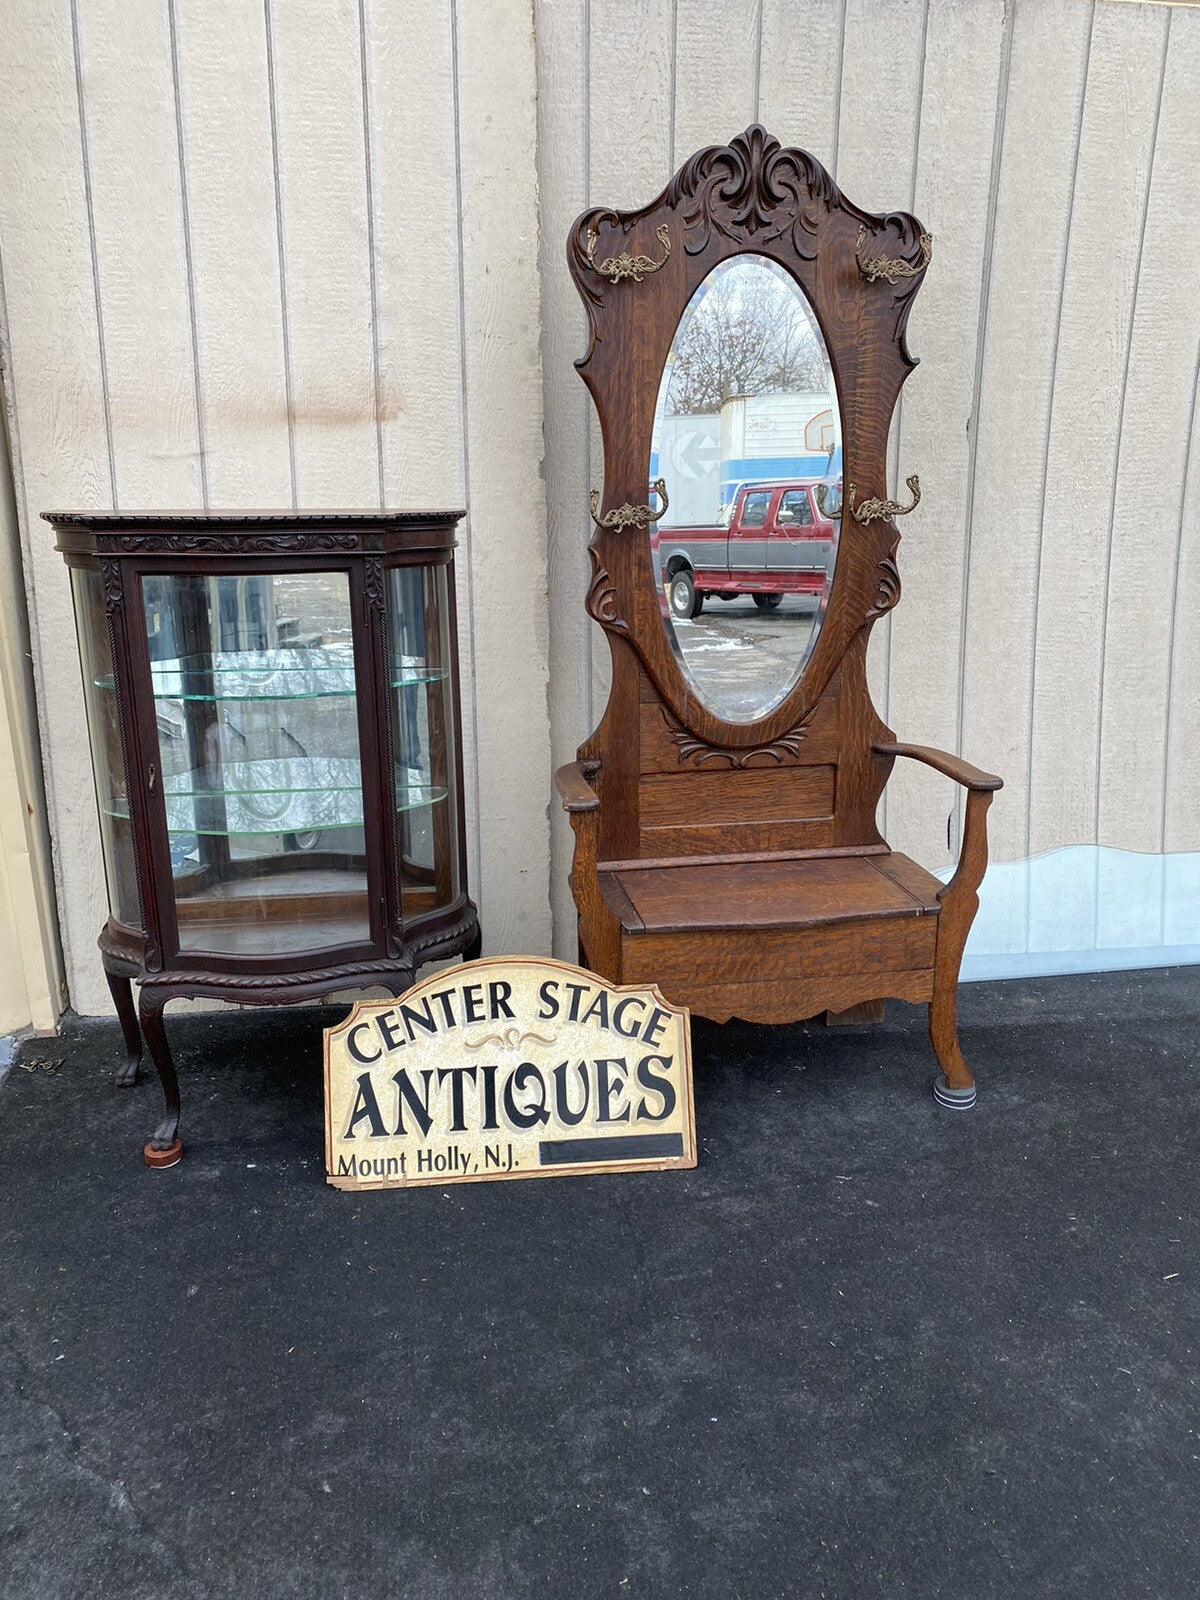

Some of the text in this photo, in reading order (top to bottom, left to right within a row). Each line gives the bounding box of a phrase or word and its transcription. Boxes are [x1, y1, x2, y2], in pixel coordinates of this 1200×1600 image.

[347, 980, 673, 1064] CENTER STAGE
[343, 1055, 677, 1139] ANTIQUES
[338, 1143, 520, 1178] Mount Holly, N.J.
